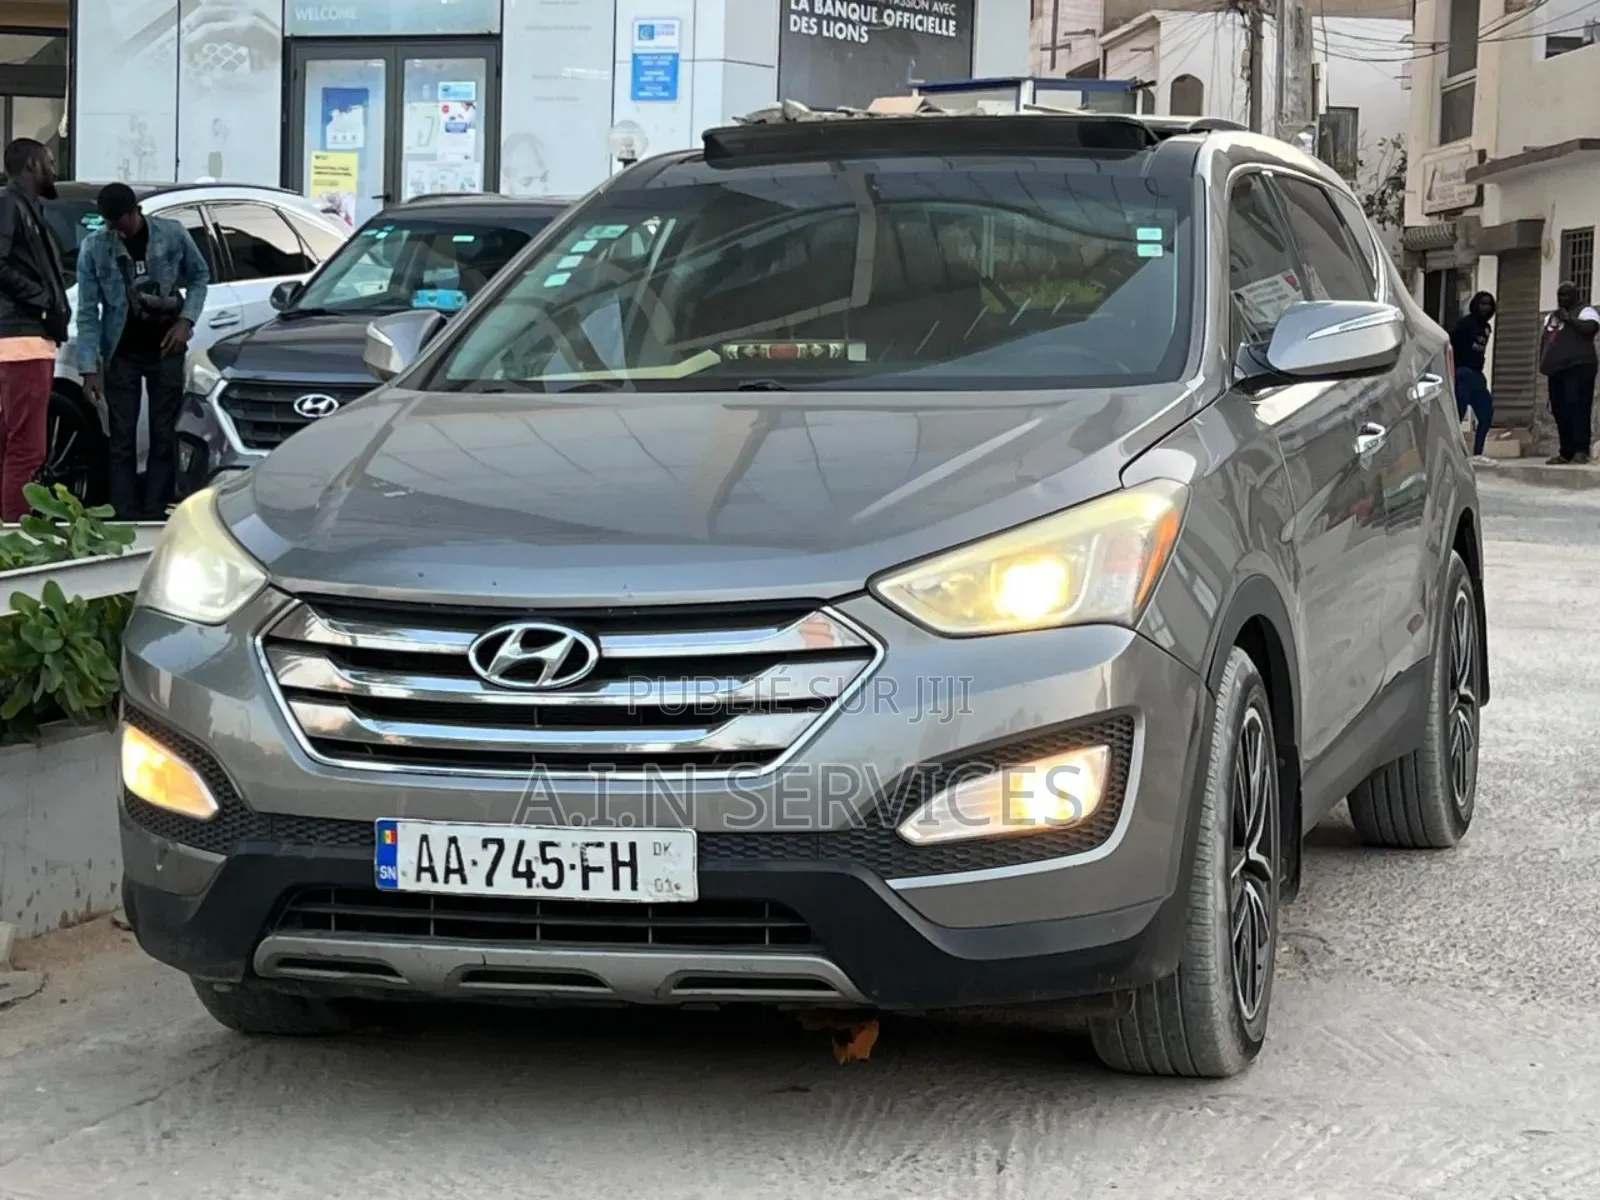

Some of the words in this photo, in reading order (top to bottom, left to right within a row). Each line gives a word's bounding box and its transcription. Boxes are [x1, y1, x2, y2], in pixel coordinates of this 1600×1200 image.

[932, 2, 957, 16] AVEC
[790, 0, 809, 13] LA
[814, 0, 878, 24] BANQUE
[883, 8, 957, 37] OFFICIELLE
[789, 14, 818, 36] DES
[822, 19, 869, 43] LIONS
[652, 841, 673, 857] DK
[379, 865, 398, 881] SN
